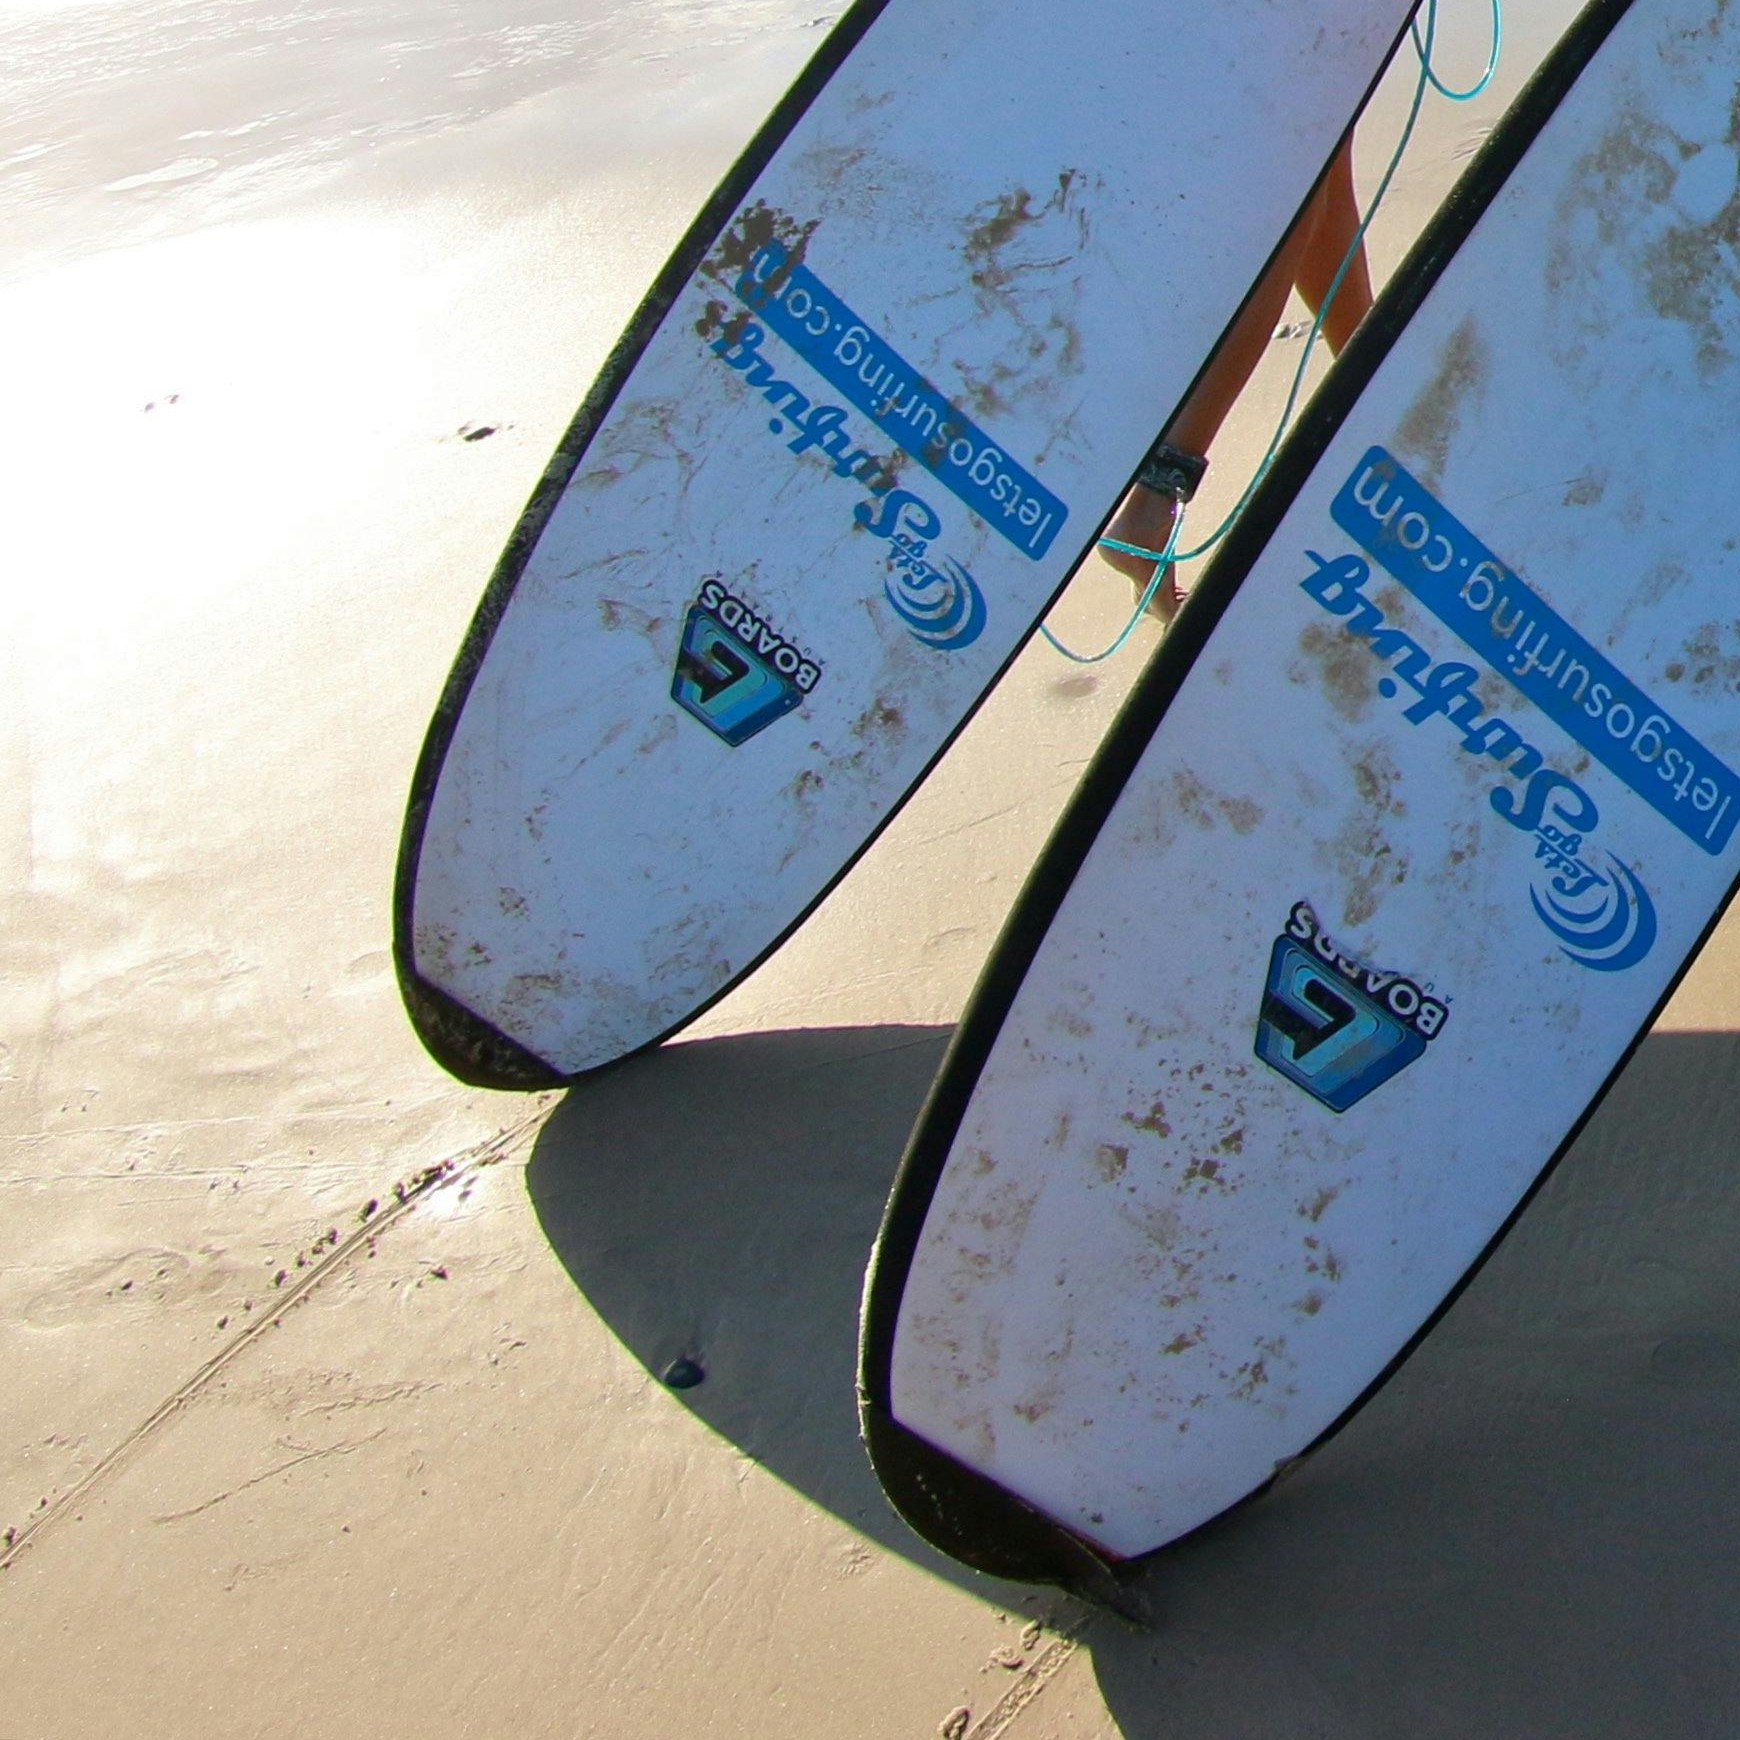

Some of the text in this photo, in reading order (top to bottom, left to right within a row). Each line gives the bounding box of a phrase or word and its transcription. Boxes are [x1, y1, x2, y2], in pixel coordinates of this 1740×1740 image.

[709, 320, 941, 540] Surfing
[701, 582, 820, 692] BOARDS
[1300, 550, 1610, 897] Lets go Surfing
[1355, 464, 1733, 840] letsgosurfing.com
